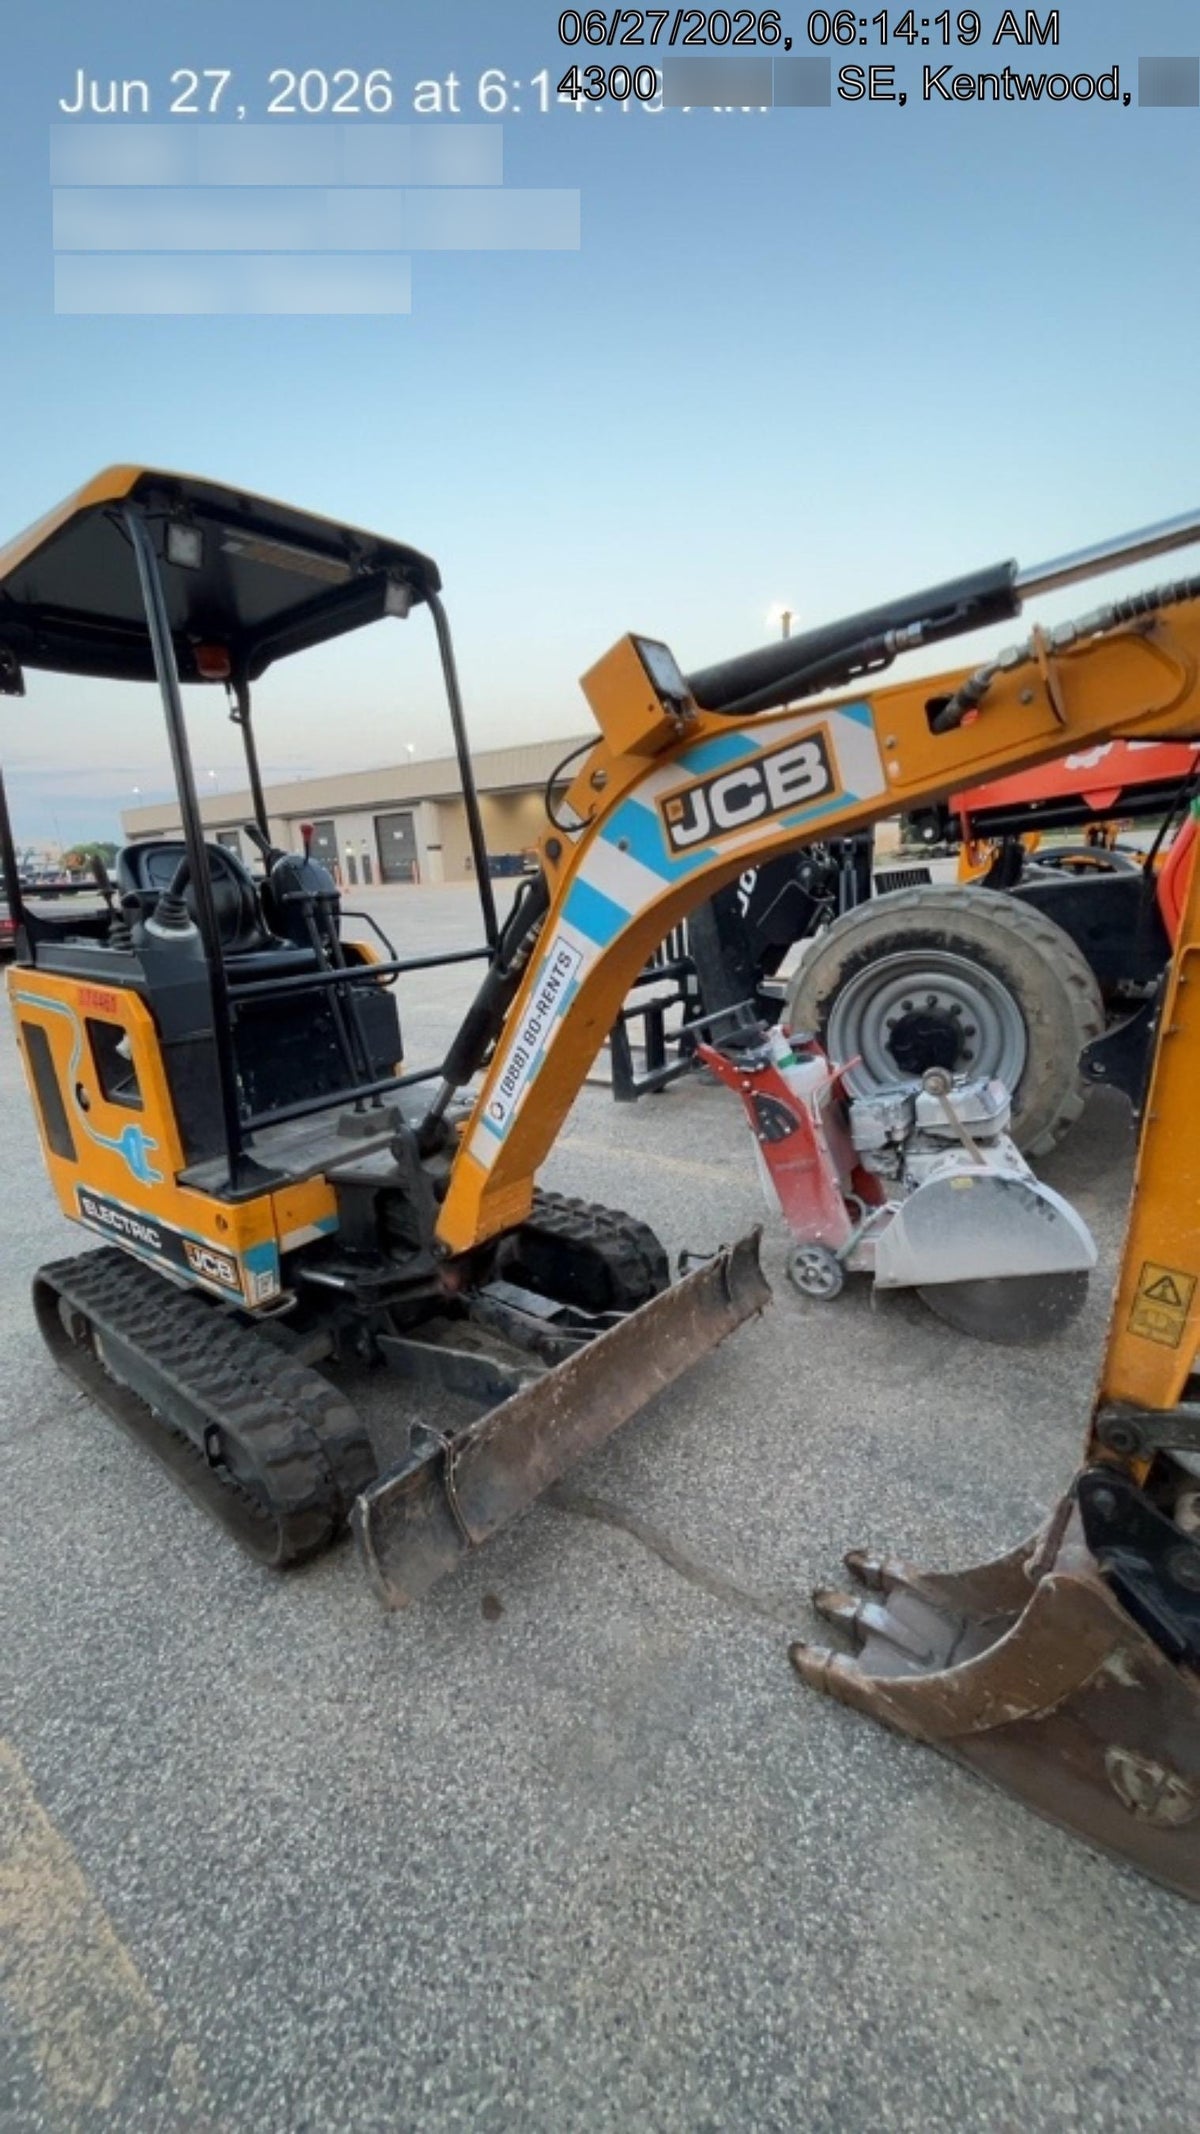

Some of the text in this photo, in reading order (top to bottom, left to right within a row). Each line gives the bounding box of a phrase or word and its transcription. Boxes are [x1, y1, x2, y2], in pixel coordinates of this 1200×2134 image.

[670, 741, 828, 846] JCB
[523, 951, 573, 1047] 80-RENTS
[82, 1196, 163, 1249] ELECTRIC
[188, 1249, 233, 1280] JCB
